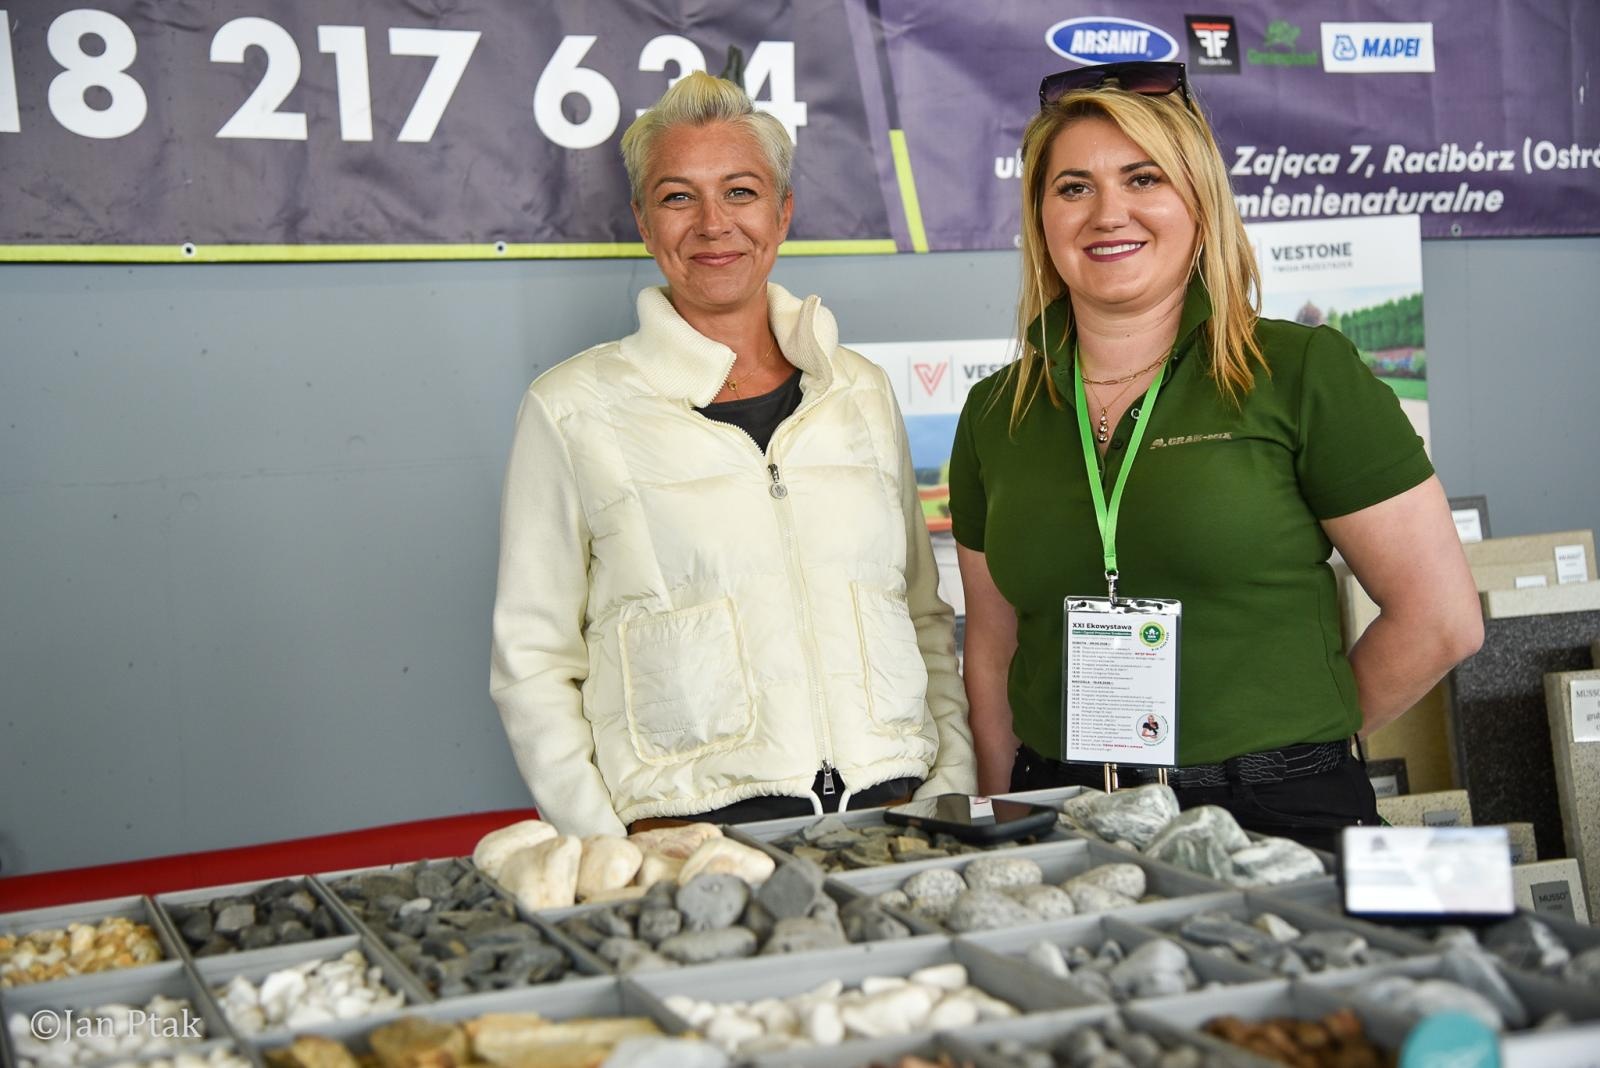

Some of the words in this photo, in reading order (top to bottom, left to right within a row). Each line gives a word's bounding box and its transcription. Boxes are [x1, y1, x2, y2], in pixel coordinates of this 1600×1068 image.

[1070, 29, 1150, 54] ARSANIT
[1362, 38, 1421, 57] MAPEI
[210, 17, 481, 142] 217
[1231, 145, 1341, 184] Zająca
[1347, 145, 1375, 179] 7,
[1383, 140, 1515, 174] Racibórz
[1272, 243, 1353, 261] VESTONE
[1086, 623, 1132, 631] Ekowystawa
